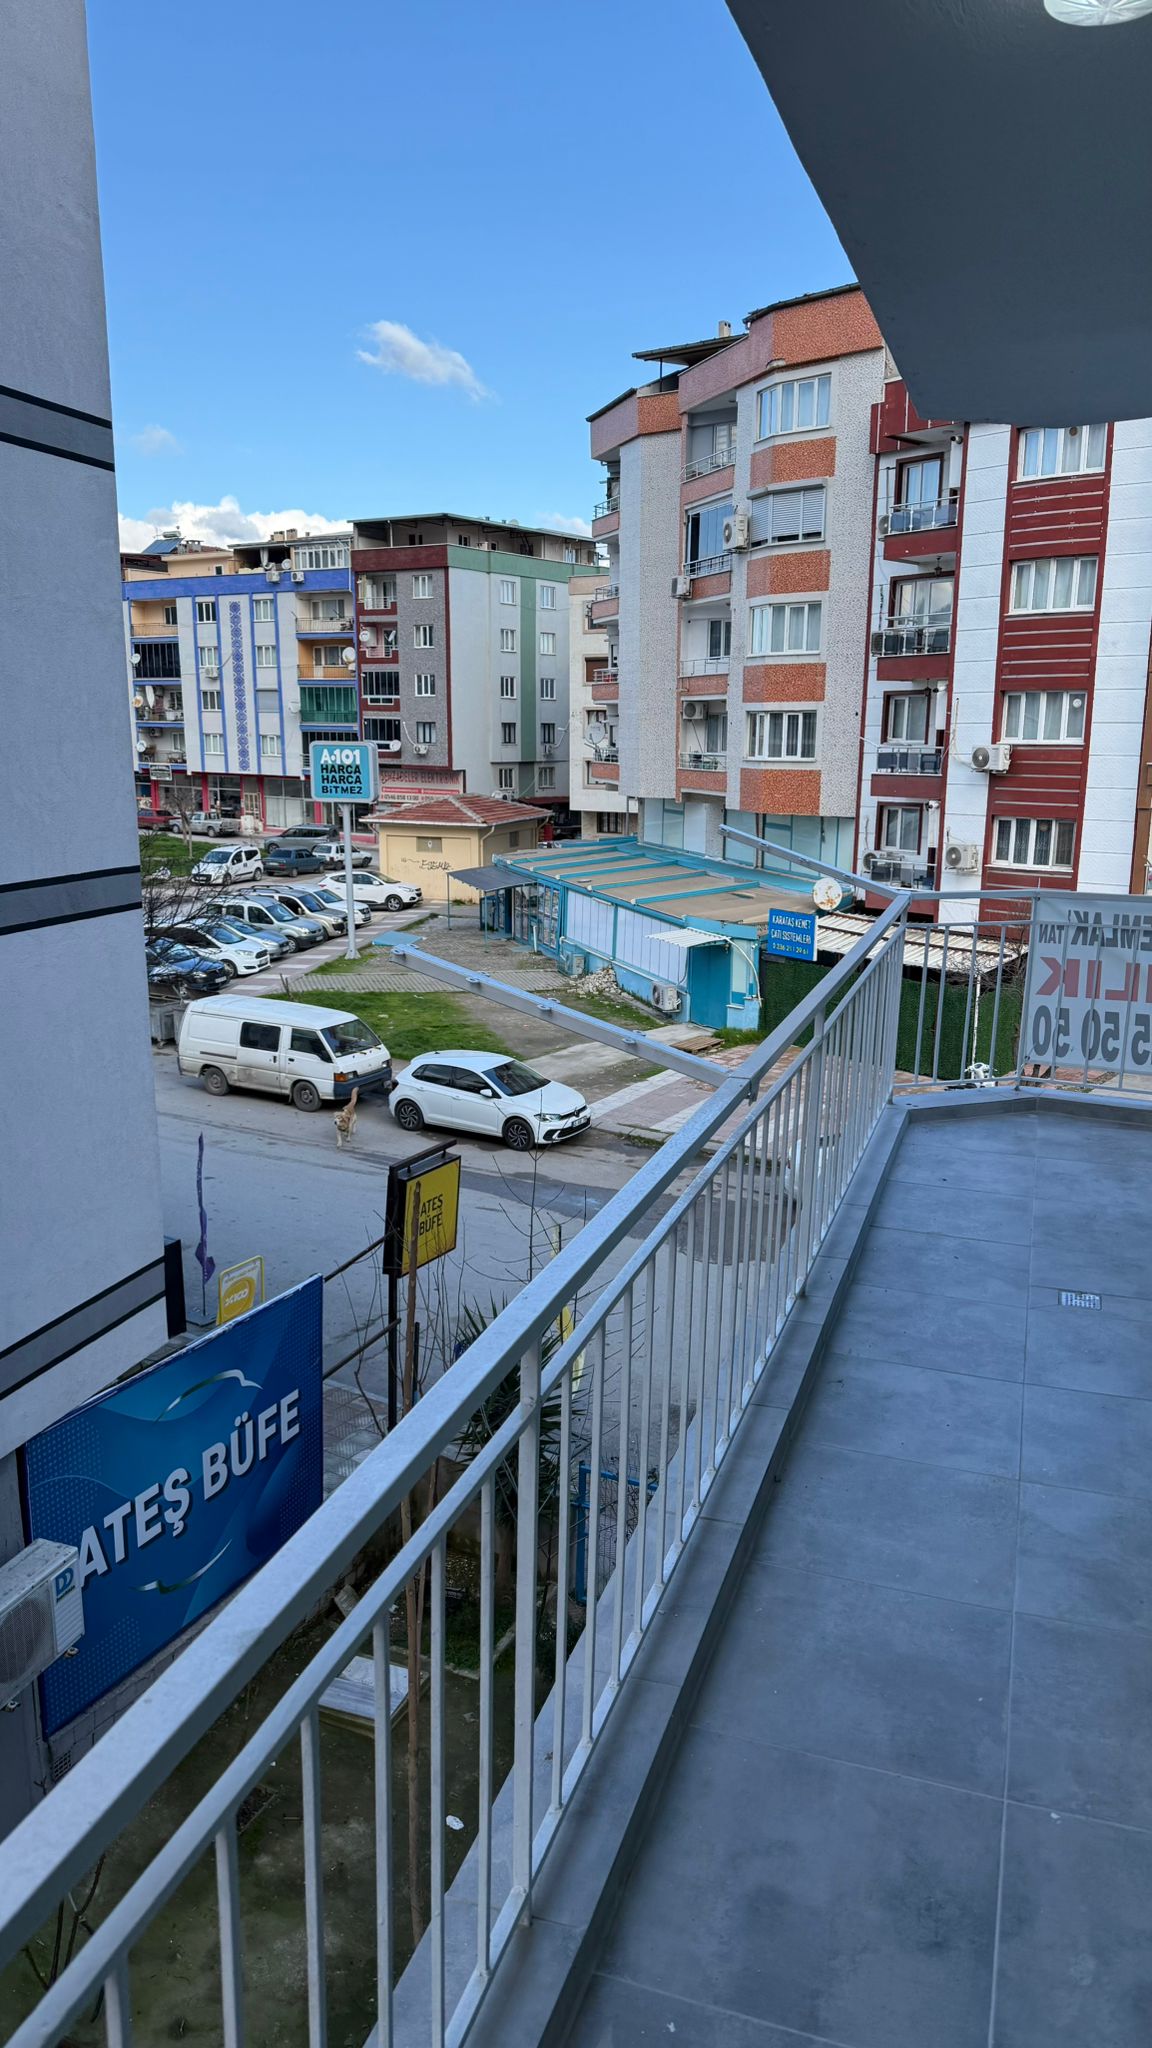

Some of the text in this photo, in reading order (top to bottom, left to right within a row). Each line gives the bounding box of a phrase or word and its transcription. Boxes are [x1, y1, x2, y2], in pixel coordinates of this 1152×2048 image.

[321, 764, 361, 774] HARCA
[321, 775, 362, 784] HARCA
[79, 1388, 300, 1589] ATEŞ BÜFE
